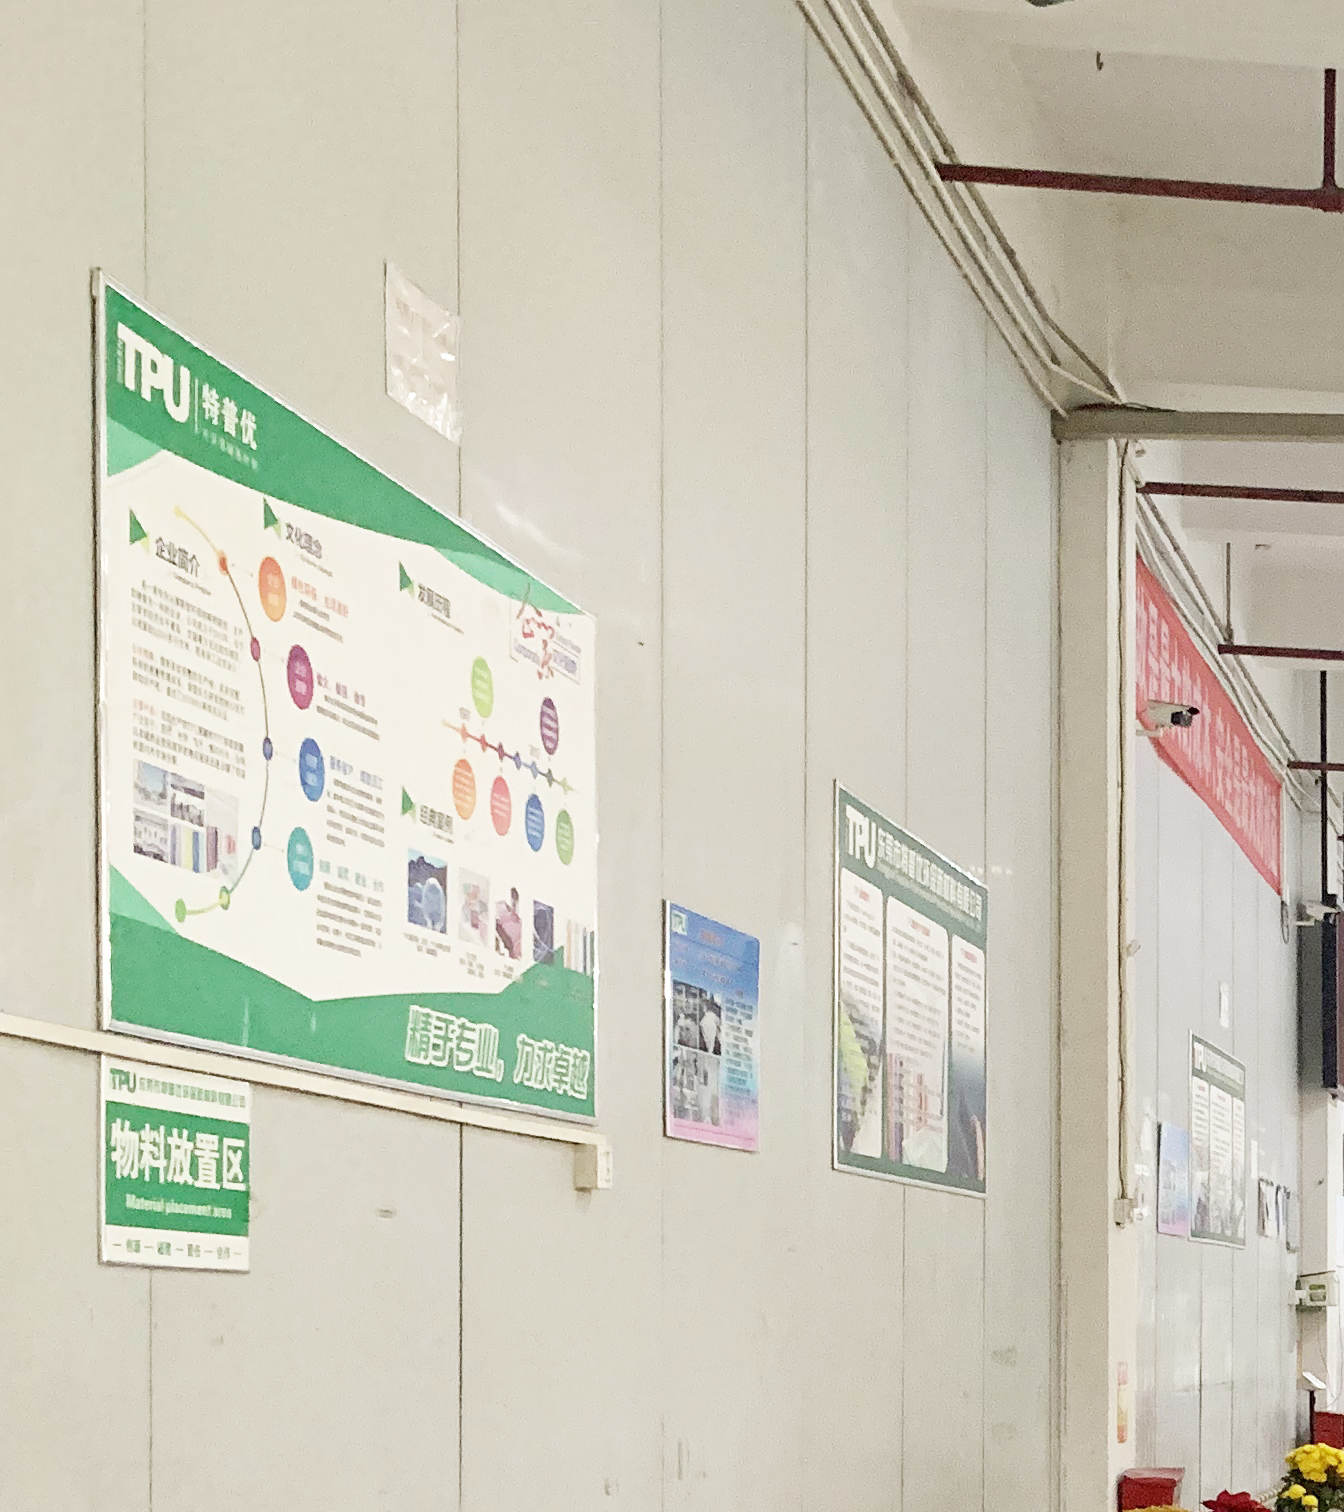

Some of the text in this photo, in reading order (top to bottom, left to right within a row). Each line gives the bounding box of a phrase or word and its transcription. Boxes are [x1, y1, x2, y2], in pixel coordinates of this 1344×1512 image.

[117, 321, 191, 424] TPU
[202, 383, 258, 450] 特普优
[155, 536, 200, 578] 企业简介
[846, 803, 877, 869] TPU
[109, 1067, 137, 1093] TPU
[111, 1117, 246, 1191] 物料放置区
